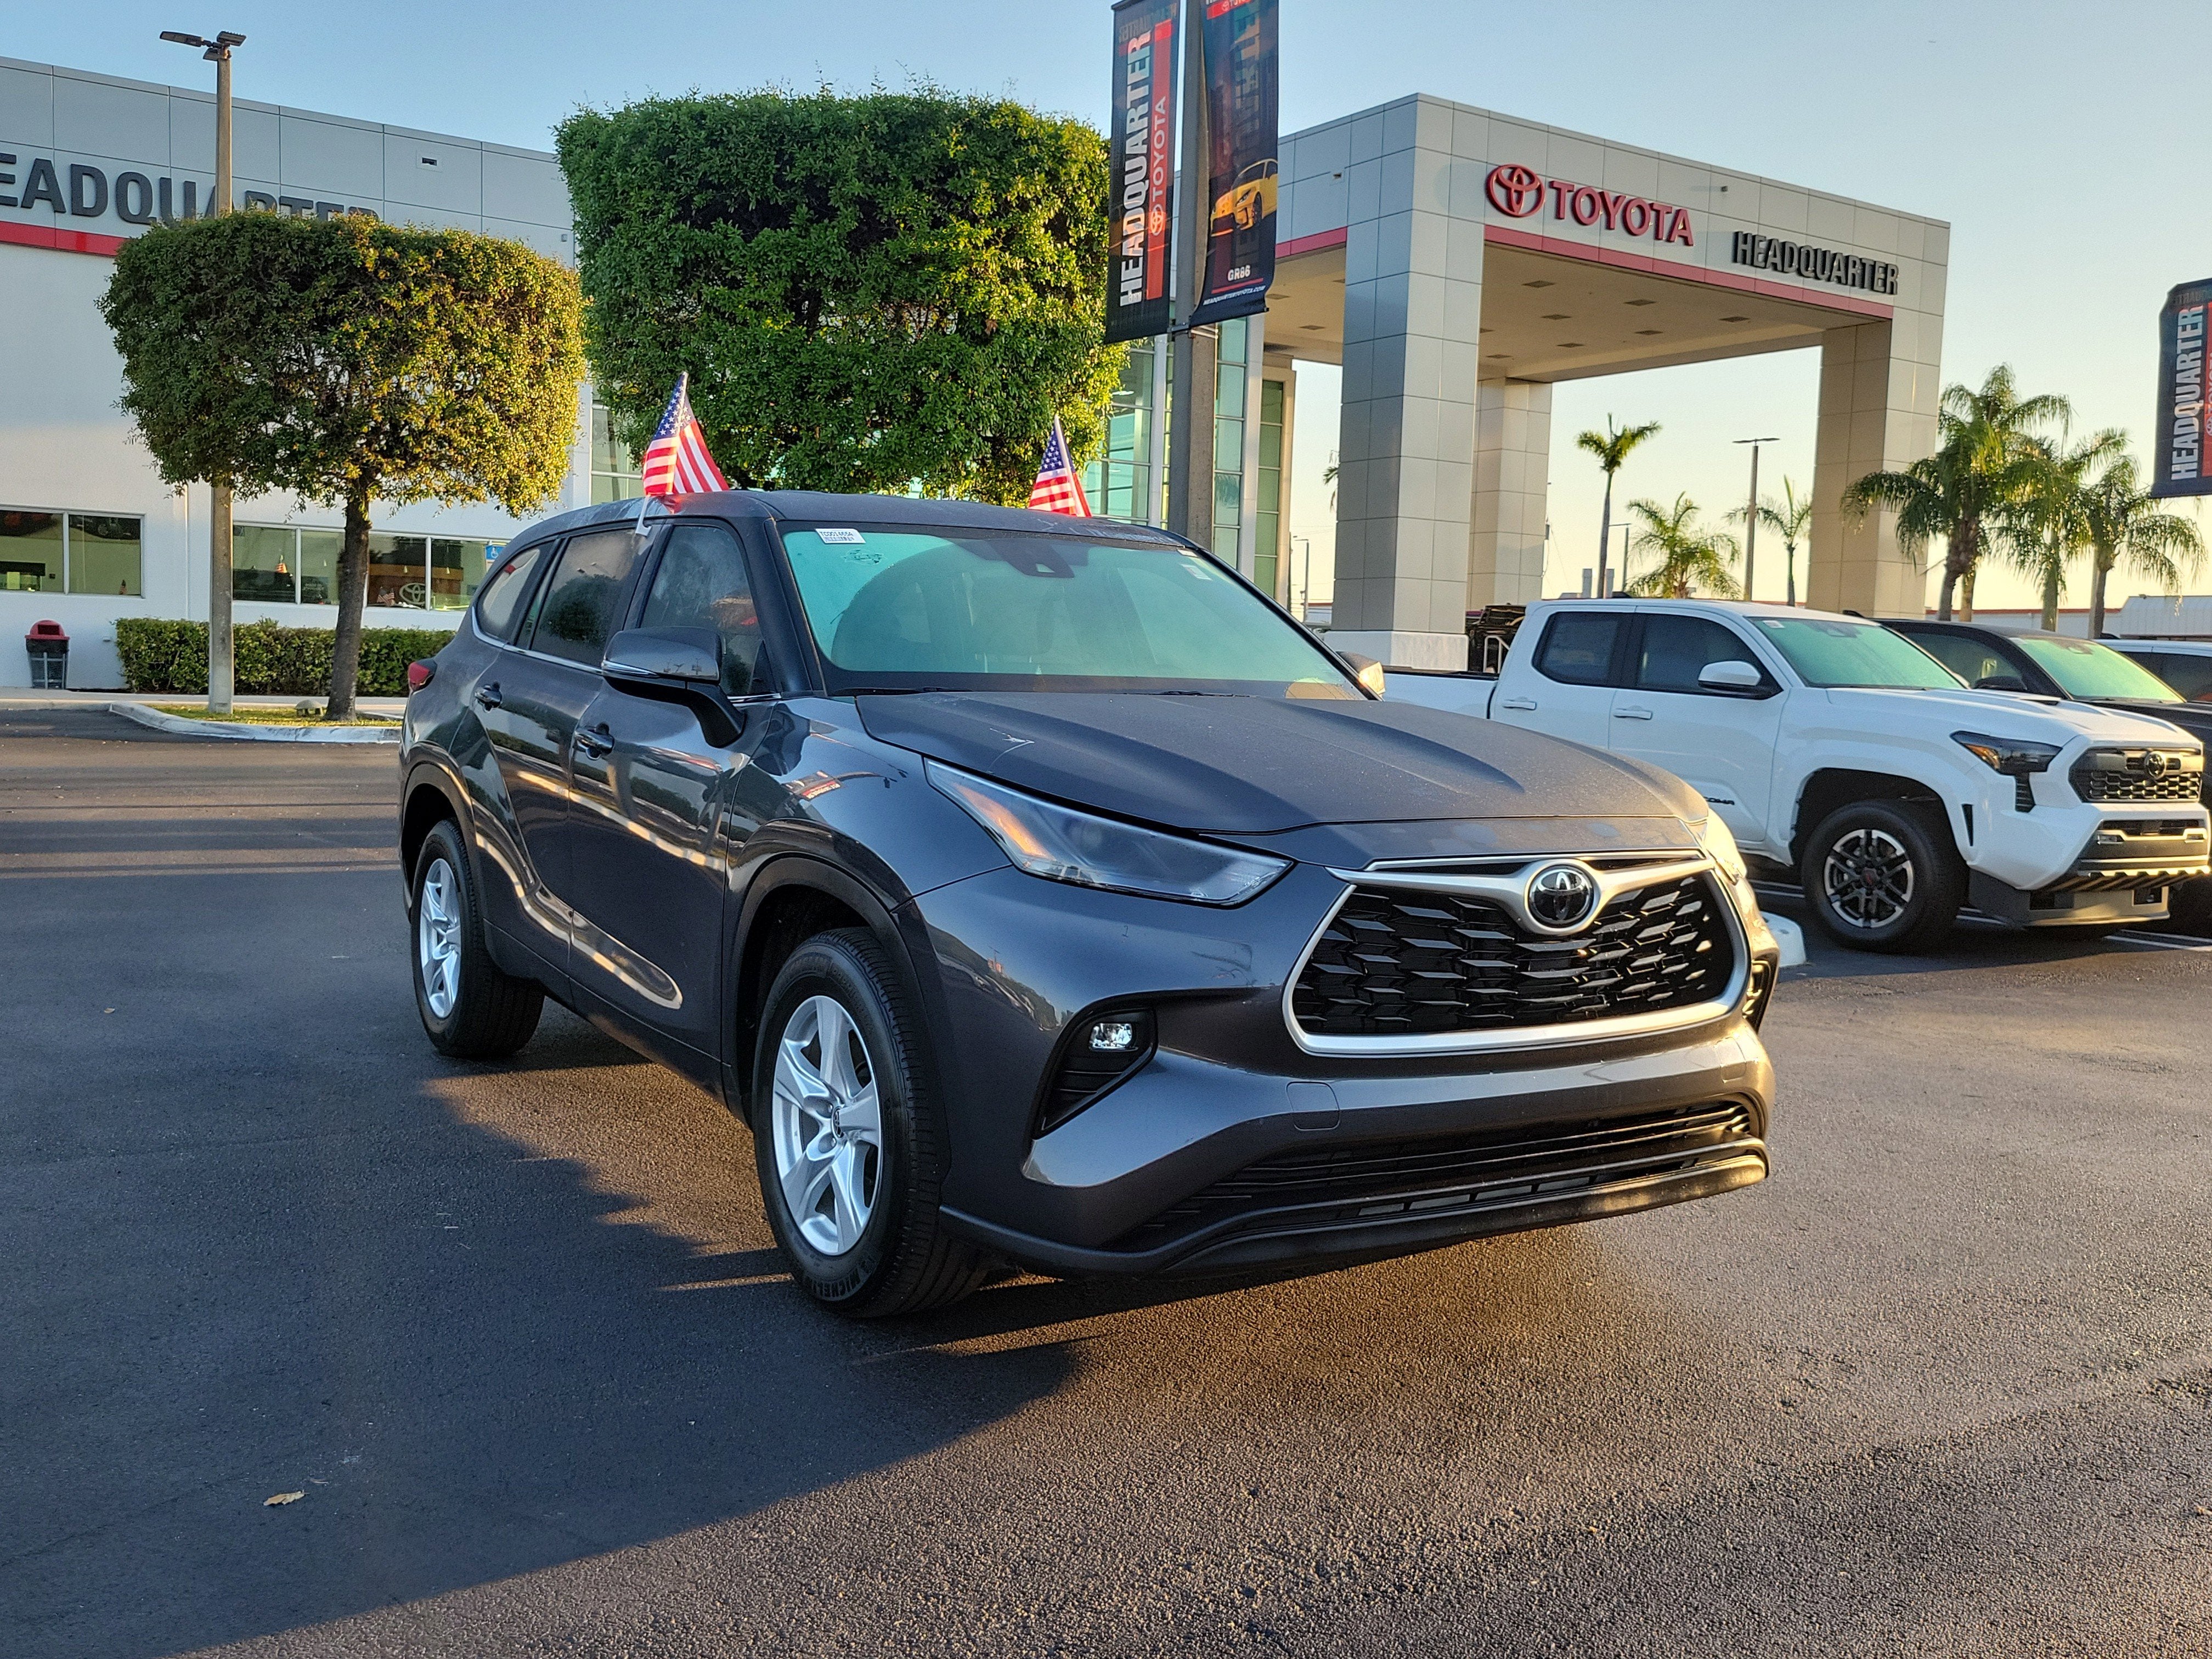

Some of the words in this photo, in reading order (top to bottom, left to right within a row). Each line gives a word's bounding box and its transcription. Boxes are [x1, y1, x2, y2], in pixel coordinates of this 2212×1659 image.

[1120, 30, 1152, 306] HEADQUARTER
[1152, 96, 1166, 202] TOYOTA
[1548, 180, 1694, 246] TOYOTA
[1227, 264, 1251, 282] GR86
[1732, 231, 1899, 295] HEADQUARTER
[2171, 304, 2204, 481] HEADQUARTER
